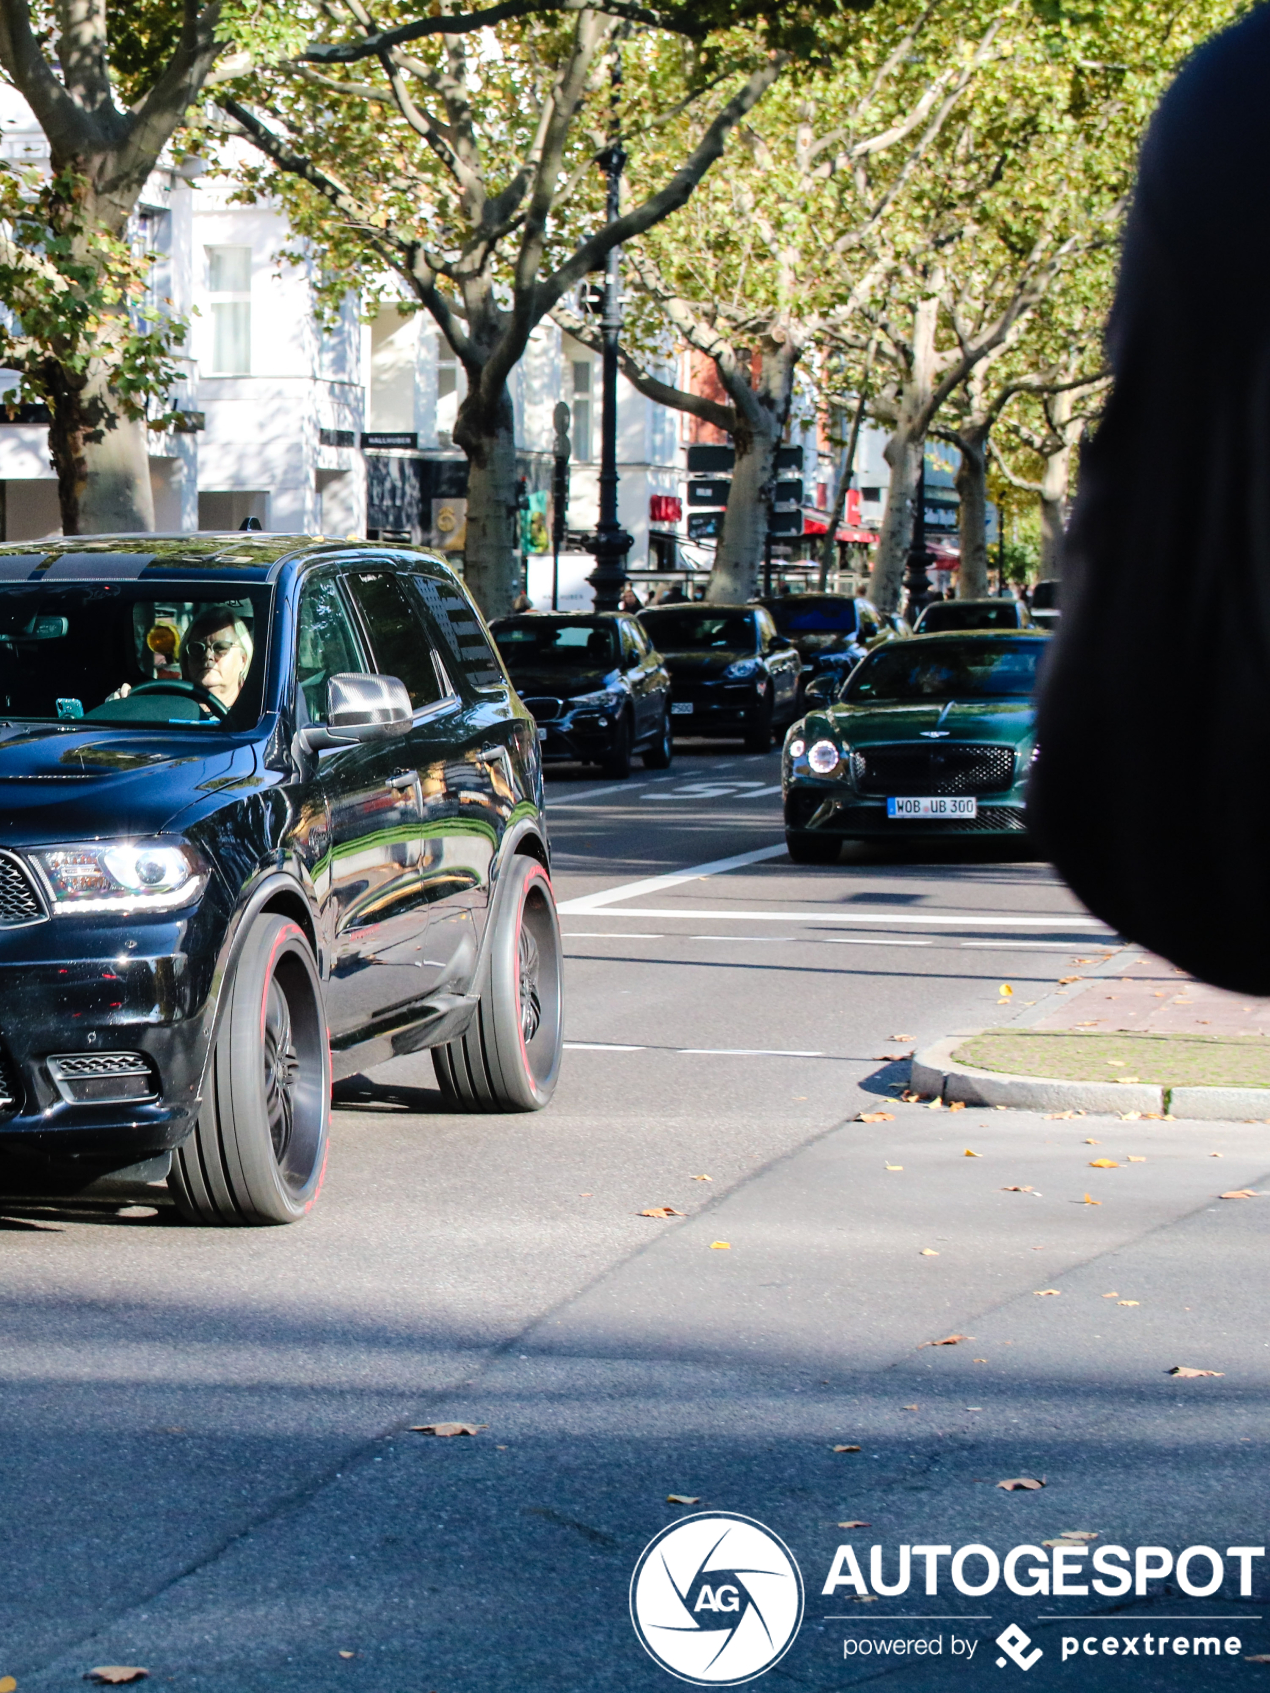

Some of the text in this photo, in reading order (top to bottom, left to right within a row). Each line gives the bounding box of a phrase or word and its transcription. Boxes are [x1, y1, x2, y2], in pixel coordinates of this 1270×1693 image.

[896, 799, 974, 814] WOB UB 300
